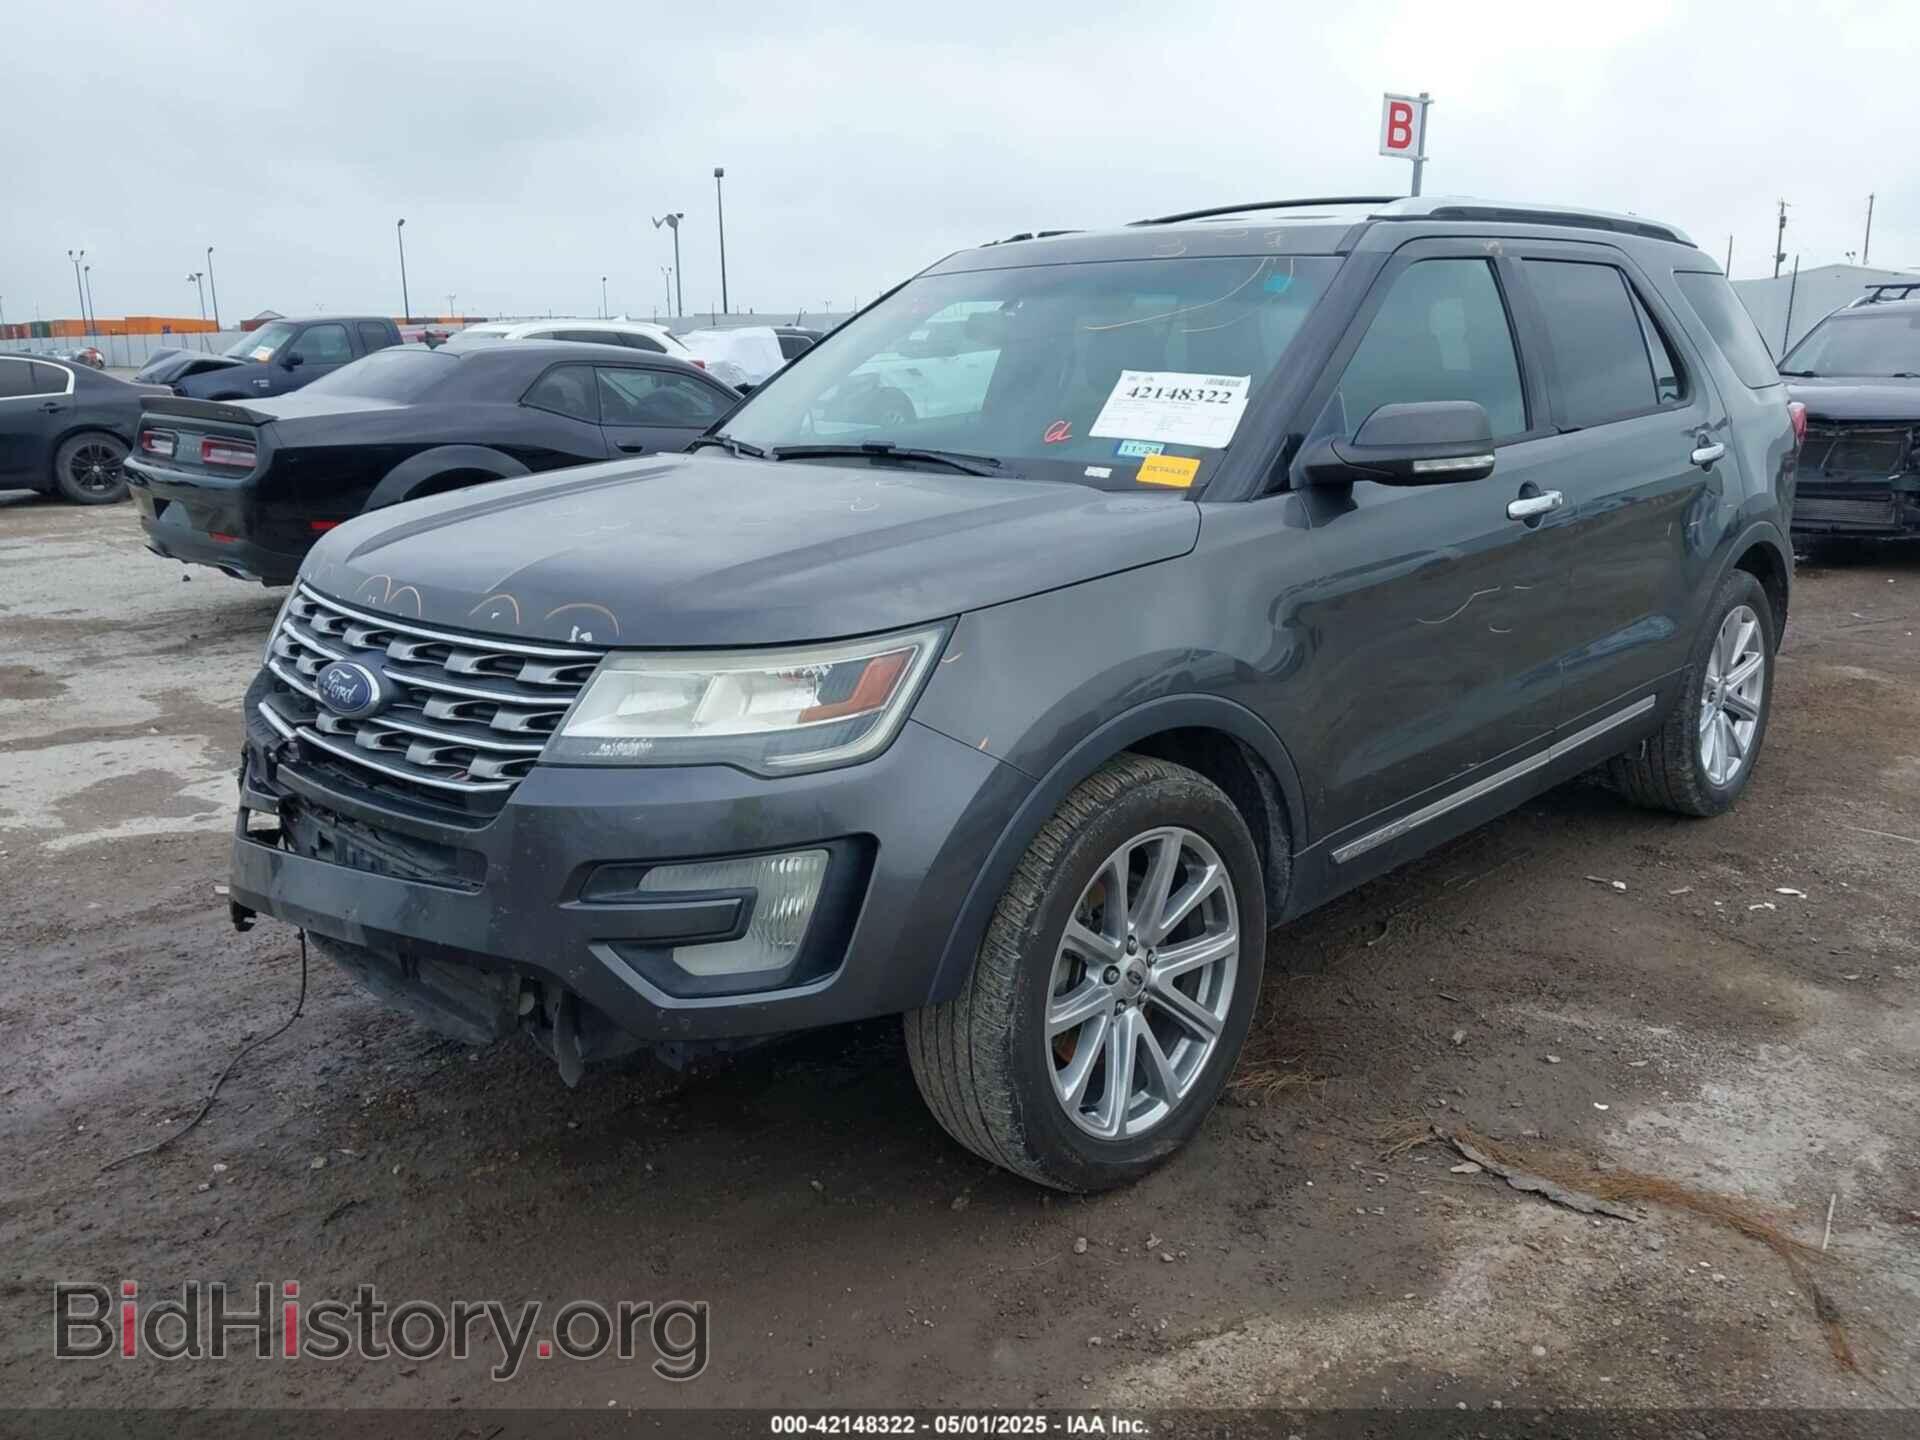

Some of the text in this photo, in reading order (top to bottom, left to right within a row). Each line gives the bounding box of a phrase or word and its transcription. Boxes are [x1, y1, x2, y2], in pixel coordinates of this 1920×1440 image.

[1387, 101, 1413, 149] B
[1126, 386, 1232, 404] 42148322
[323, 668, 359, 704] Ford
